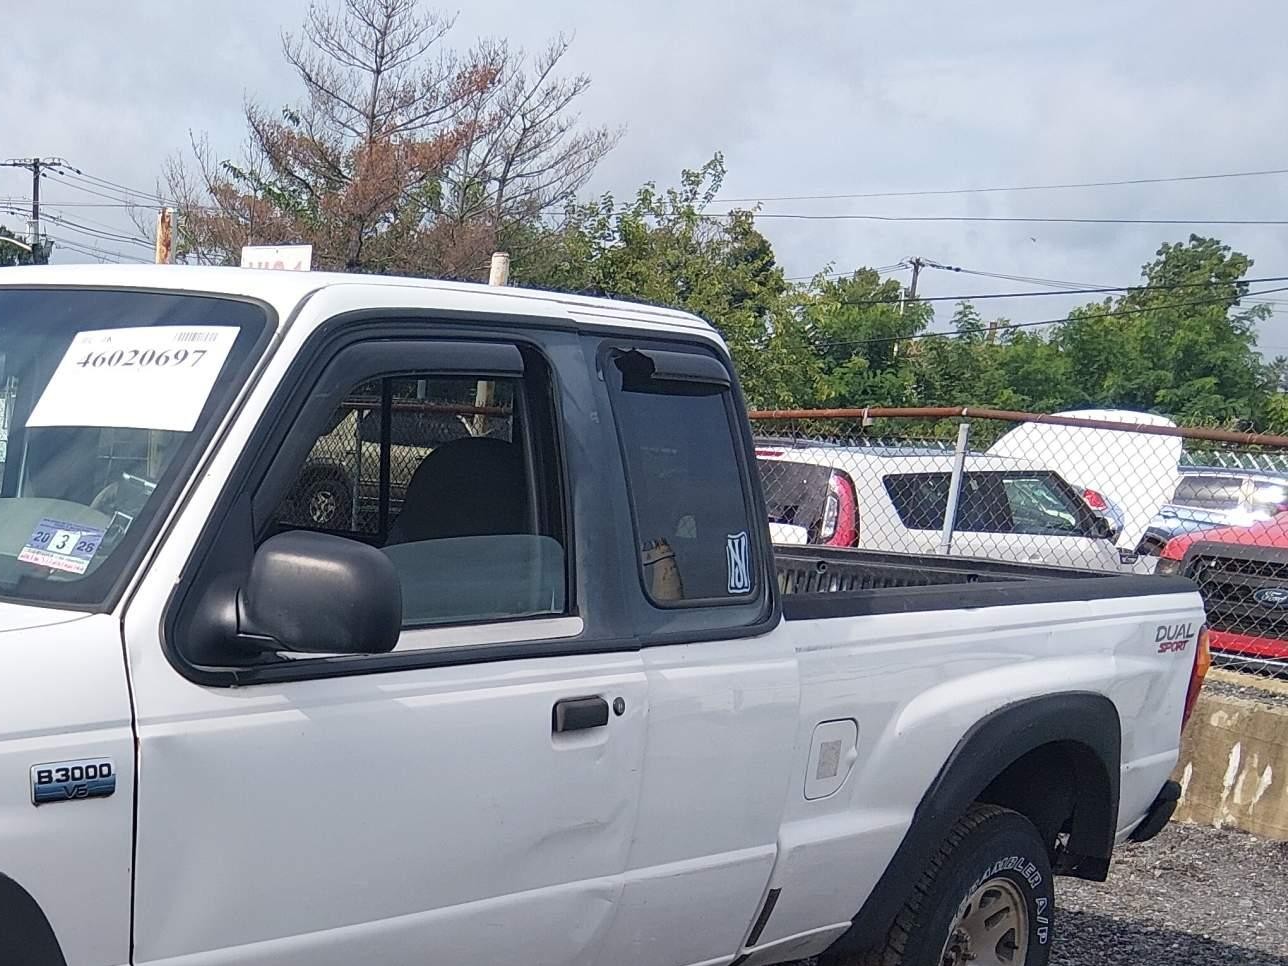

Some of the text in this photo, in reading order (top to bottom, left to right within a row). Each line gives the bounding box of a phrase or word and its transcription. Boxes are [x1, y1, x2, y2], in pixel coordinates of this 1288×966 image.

[76, 349, 208, 368] 46020697
[33, 531, 50, 543] 20
[56, 534, 70, 549] 3
[1154, 622, 1195, 643] DUAL
[1157, 640, 1190, 653] SPORT
[37, 763, 112, 785] B3000
[64, 784, 89, 799] V6
